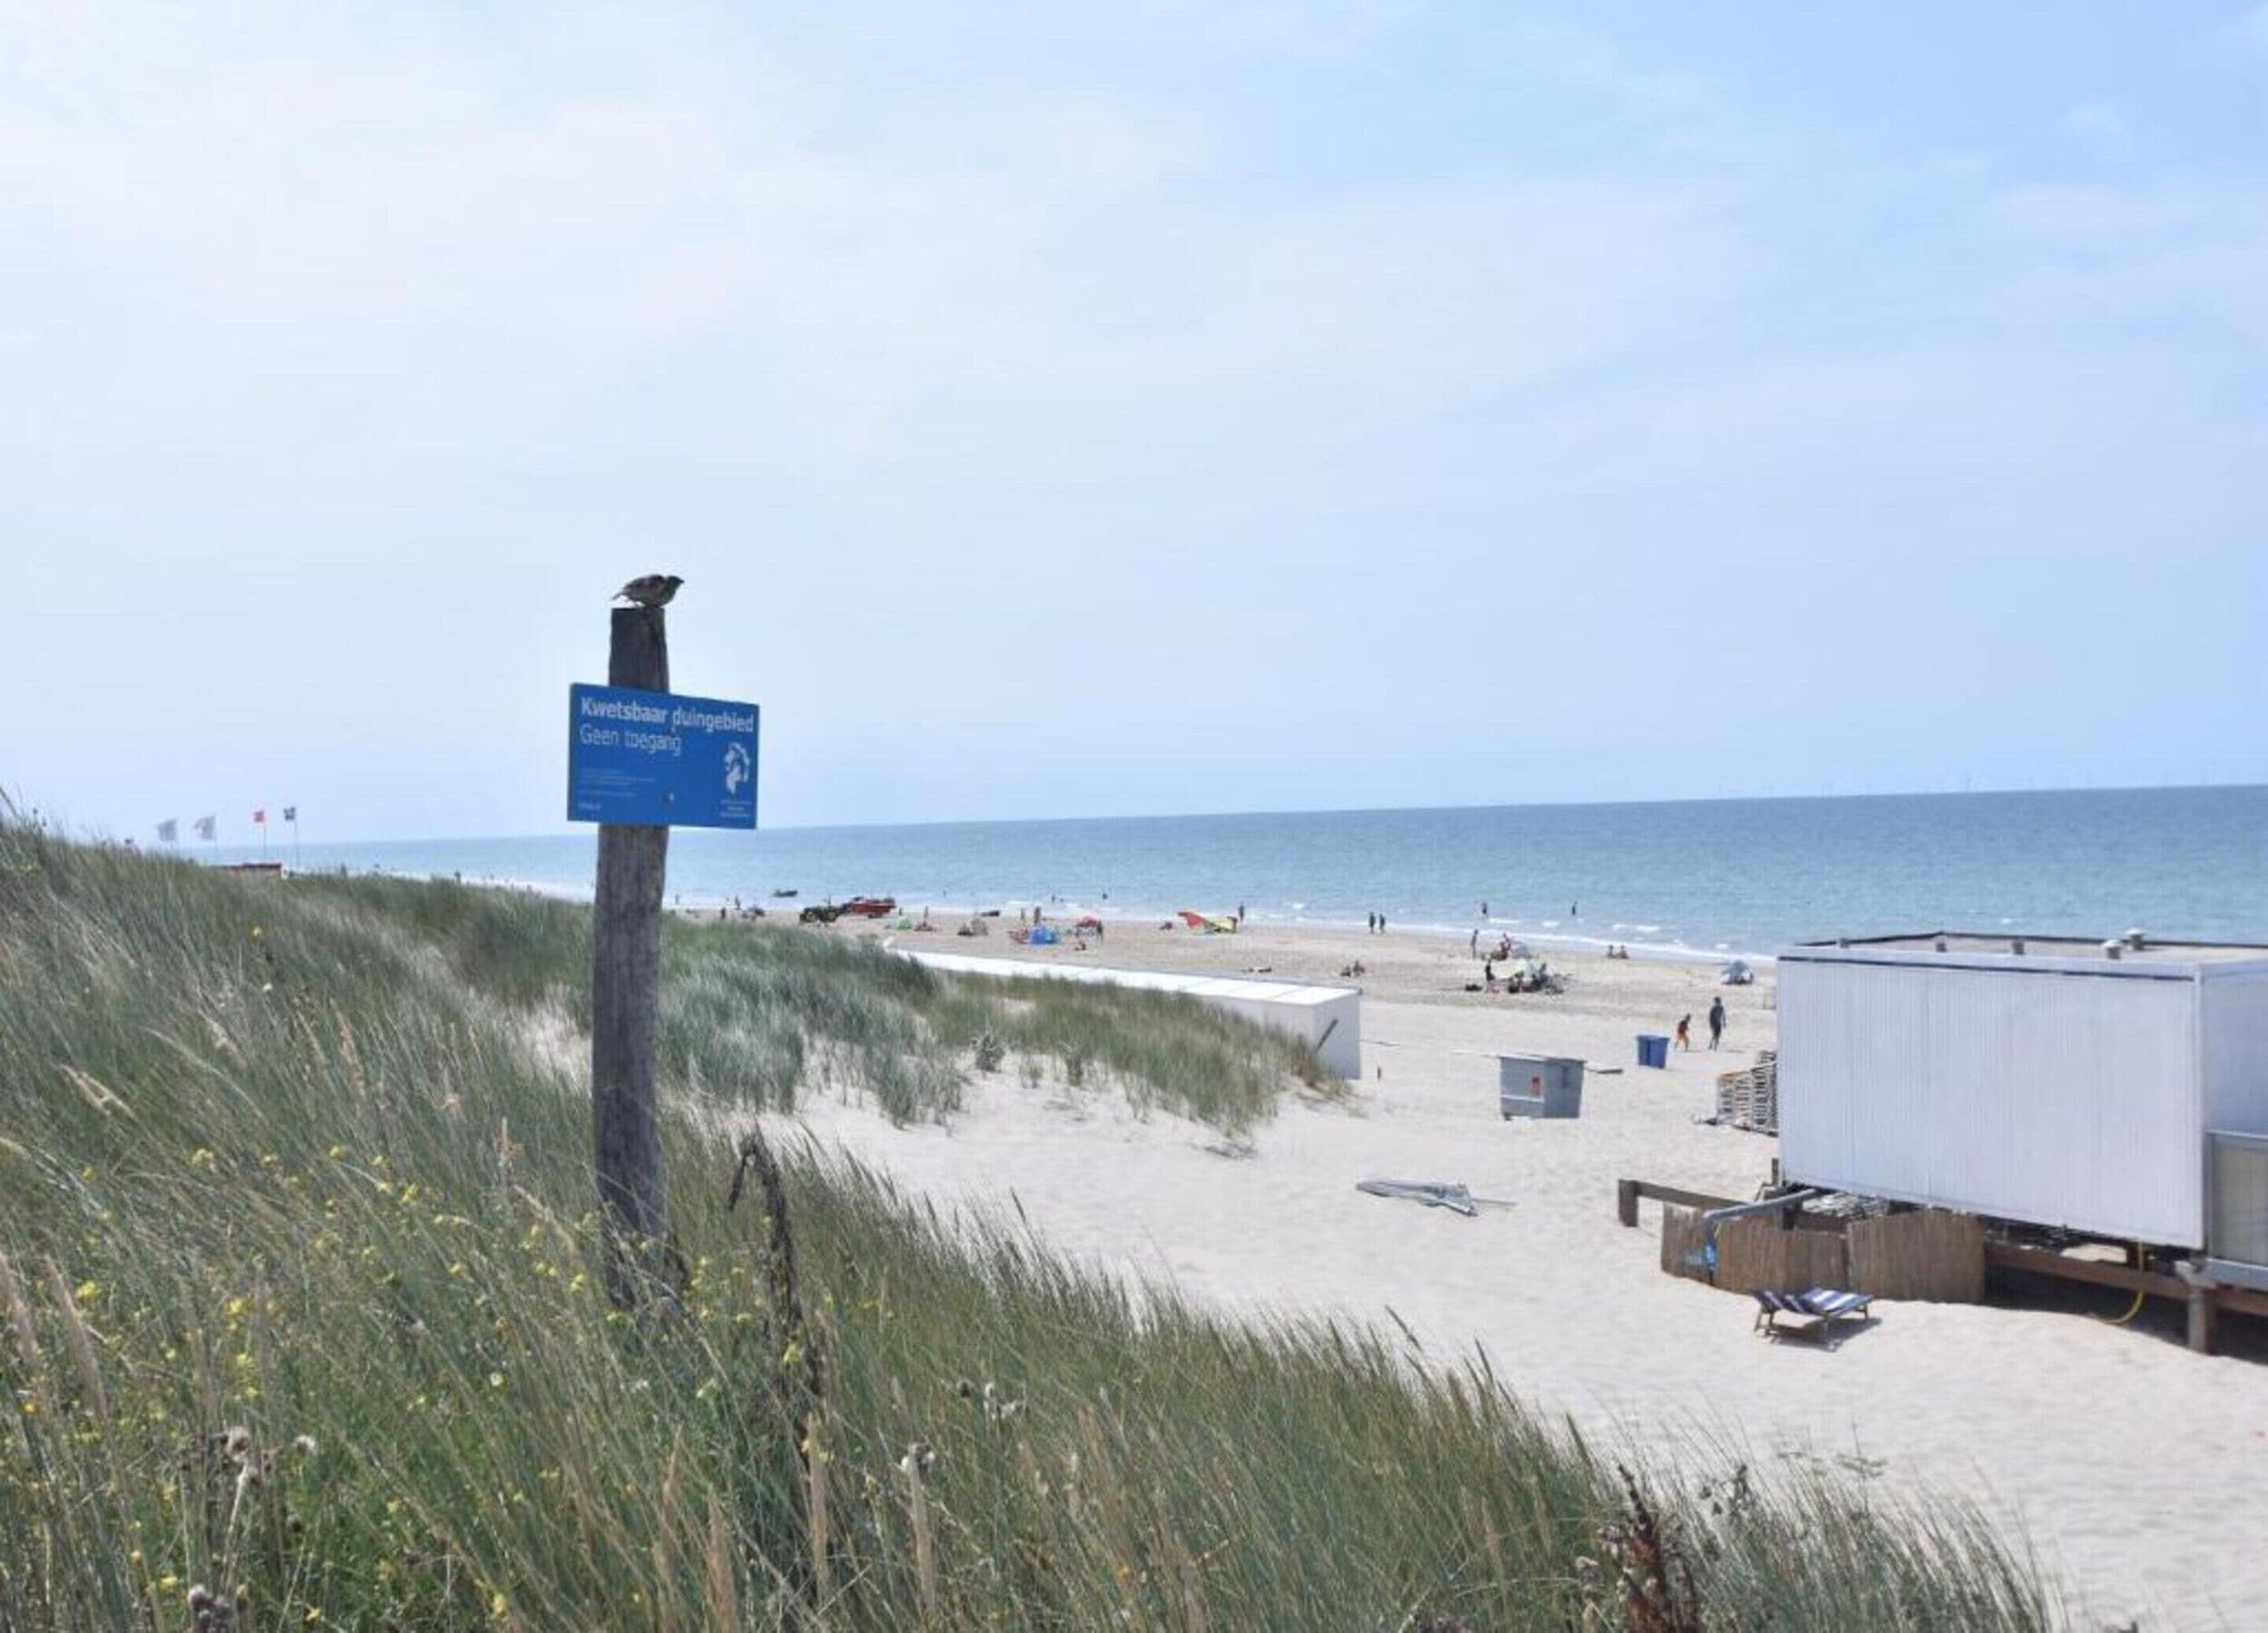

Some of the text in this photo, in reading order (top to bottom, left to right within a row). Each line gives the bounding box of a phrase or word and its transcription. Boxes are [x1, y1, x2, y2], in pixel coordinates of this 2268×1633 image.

[581, 697, 754, 732] Kwetsbaar duingebied
[580, 724, 681, 756] Geen toegang
